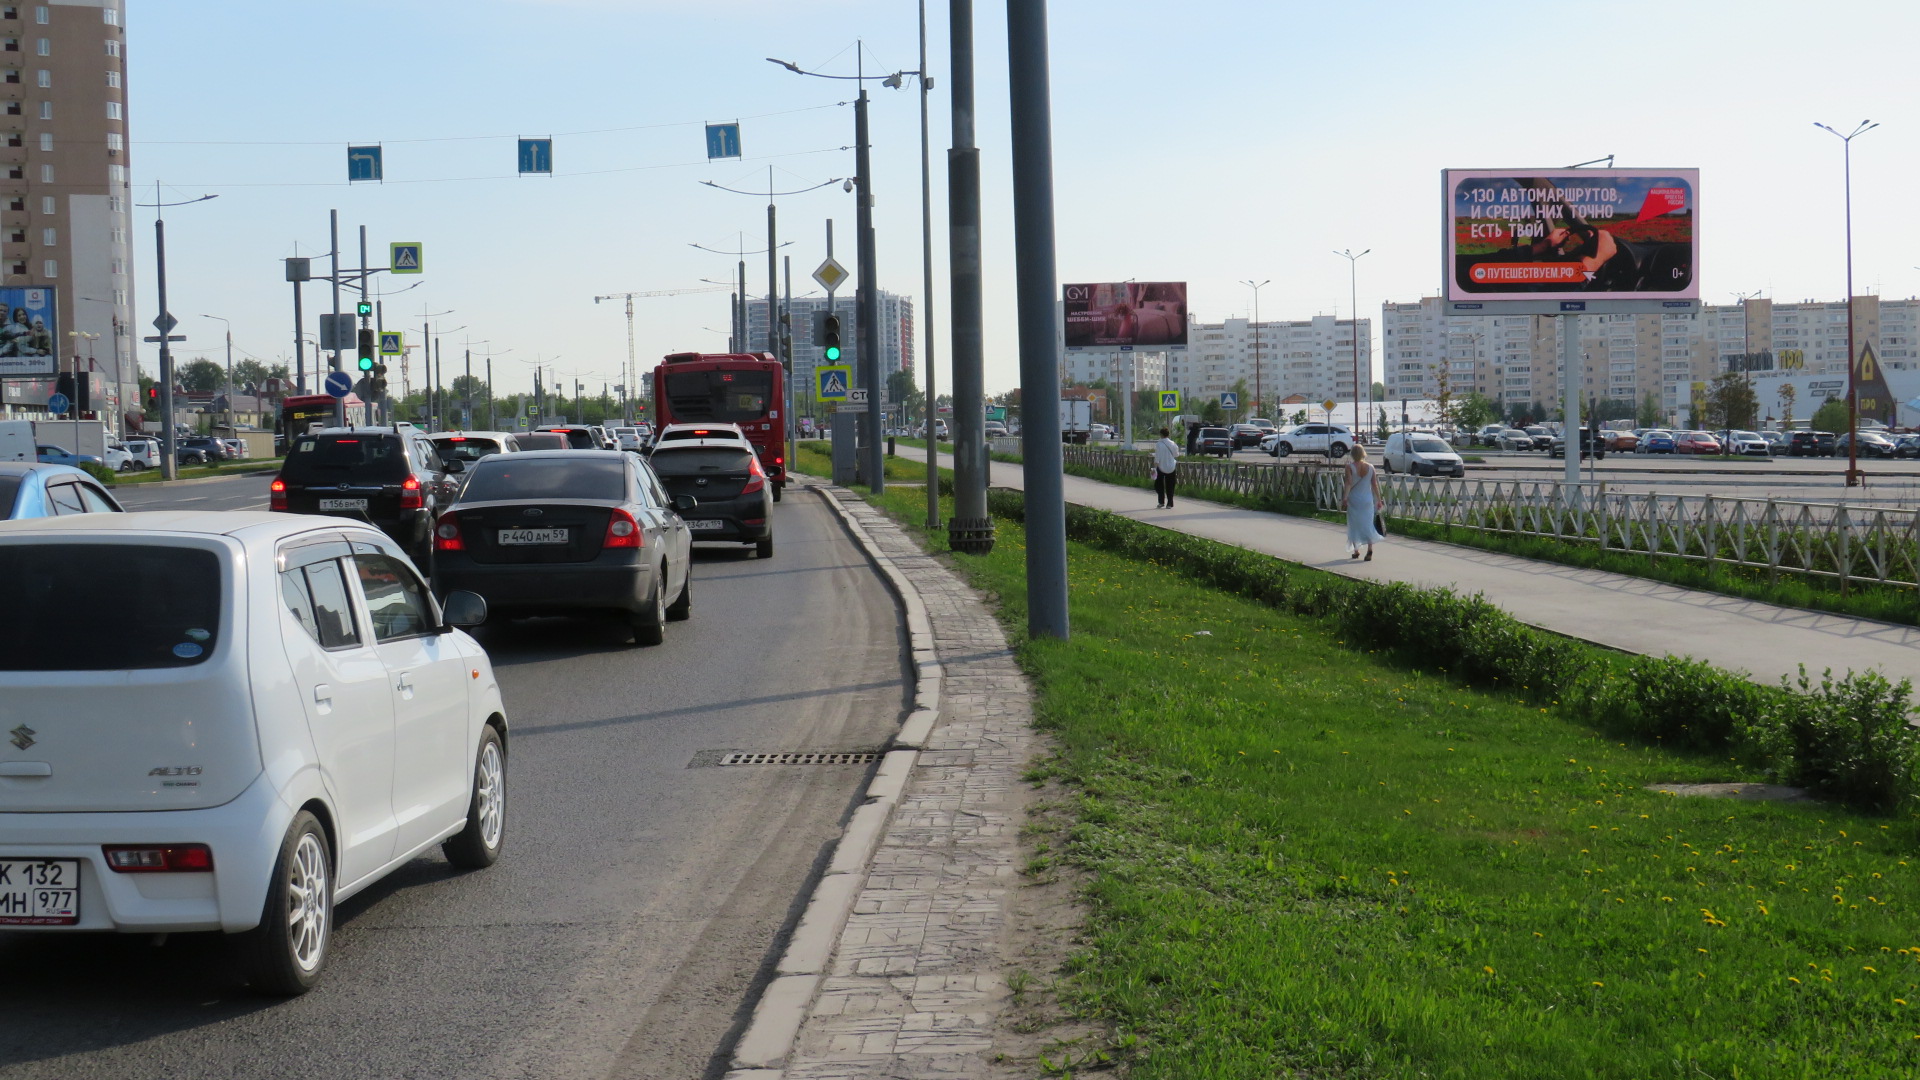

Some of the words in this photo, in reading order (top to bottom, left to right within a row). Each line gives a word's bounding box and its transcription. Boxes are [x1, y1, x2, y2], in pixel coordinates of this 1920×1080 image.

[1501, 188, 1622, 204] АВТОМАРШРУТОВ,
[1471, 206, 1480, 219] И
[1486, 205, 1530, 221] СРЕДИ
[1536, 205, 1563, 218] НИХ
[1571, 205, 1613, 219] ТОЧНО
[1471, 223, 1502, 237] ЕСТЬ
[1508, 220, 1544, 237] ТВОЙ
[1487, 267, 1574, 280] ПУТЕШЕСТВУЕМ.РФ
[1672, 267, 1684, 279] 0+
[360, 305, 370, 314] 04
[1778, 349, 1804, 370] ПРО
[852, 391, 883, 400] СТ!
[1861, 398, 1876, 410] ПРО
[553, 530, 565, 539] 59
[148, 766, 203, 776] ALTO
[22, 864, 63, 885] 132
[40, 892, 72, 908] 977
